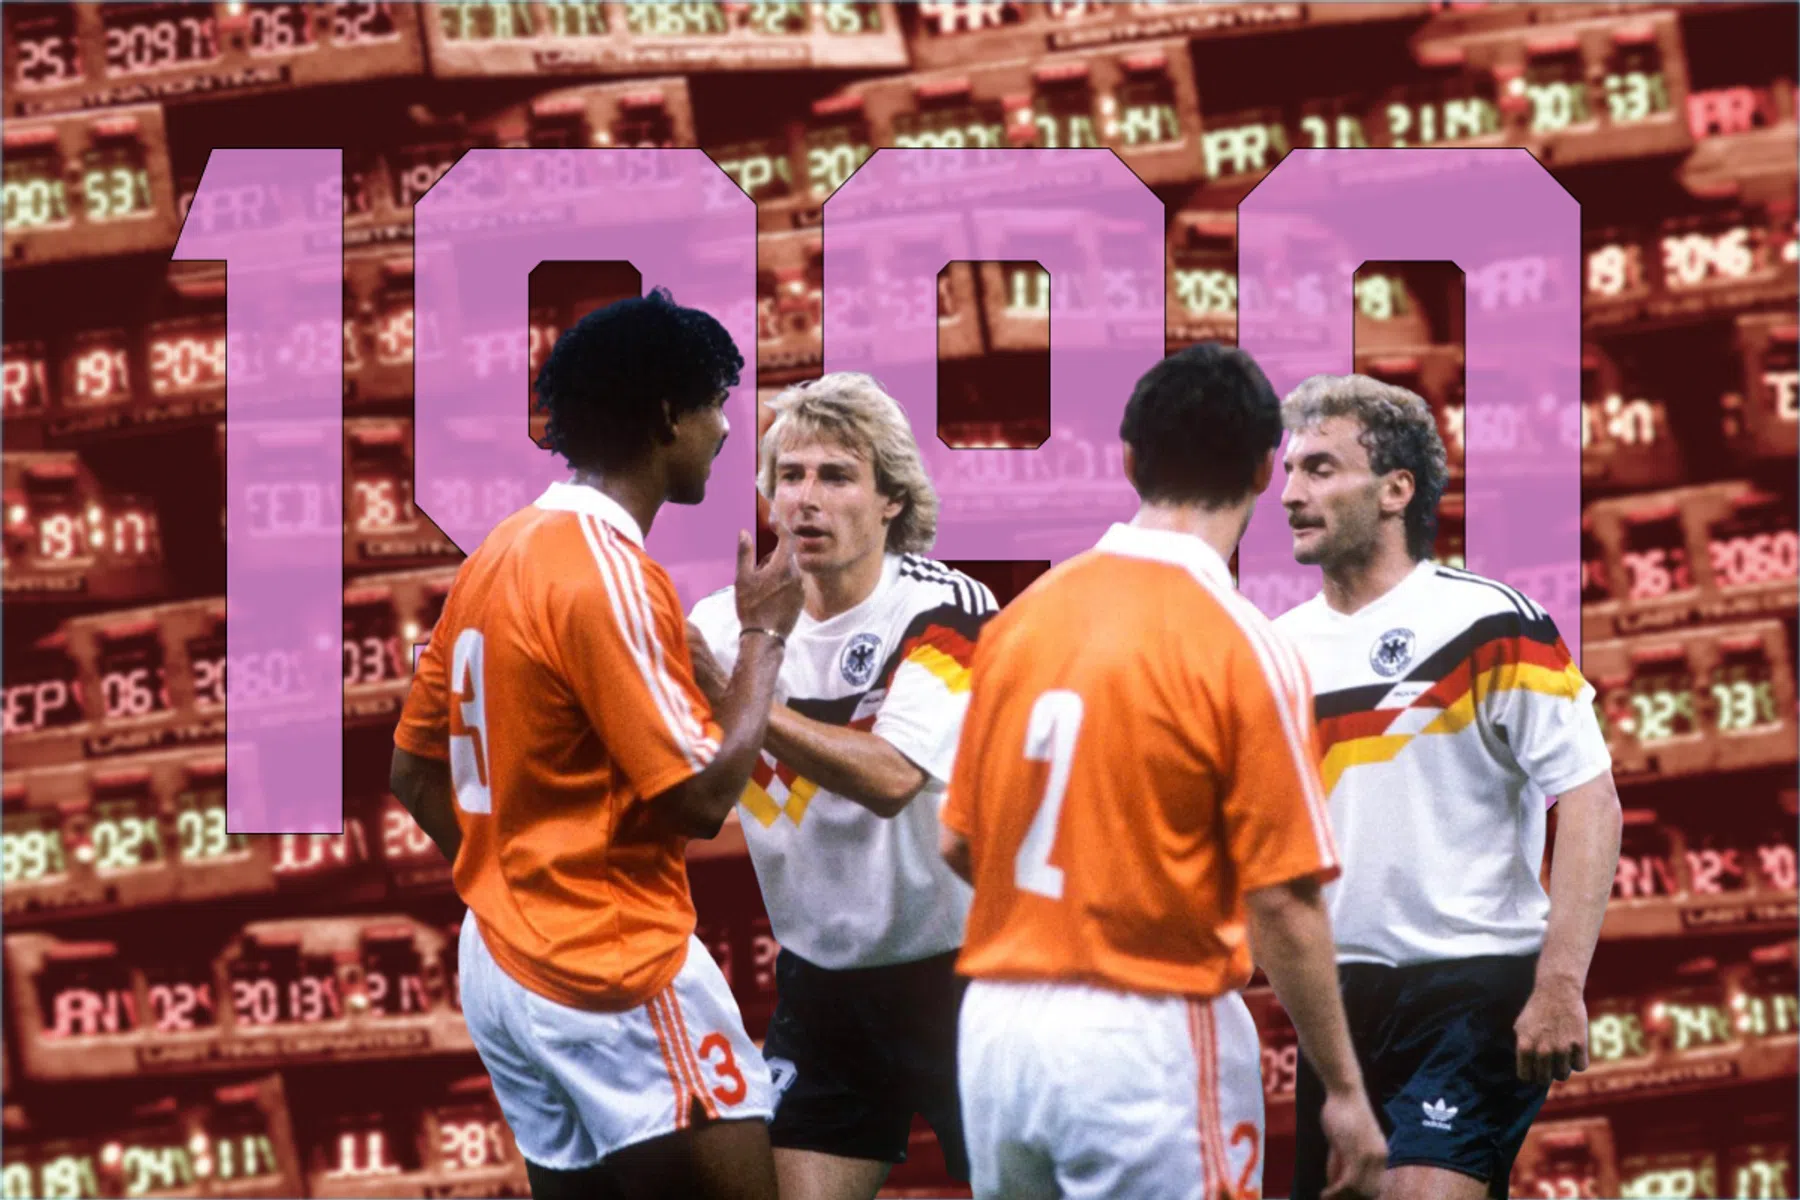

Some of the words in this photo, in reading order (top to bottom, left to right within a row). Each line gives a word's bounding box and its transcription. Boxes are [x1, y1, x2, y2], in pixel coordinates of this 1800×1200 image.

[449, 627, 492, 814] 3
[1014, 689, 1085, 901] 2
[699, 1031, 747, 1107] 3
[1229, 1119, 1262, 1200] 2
